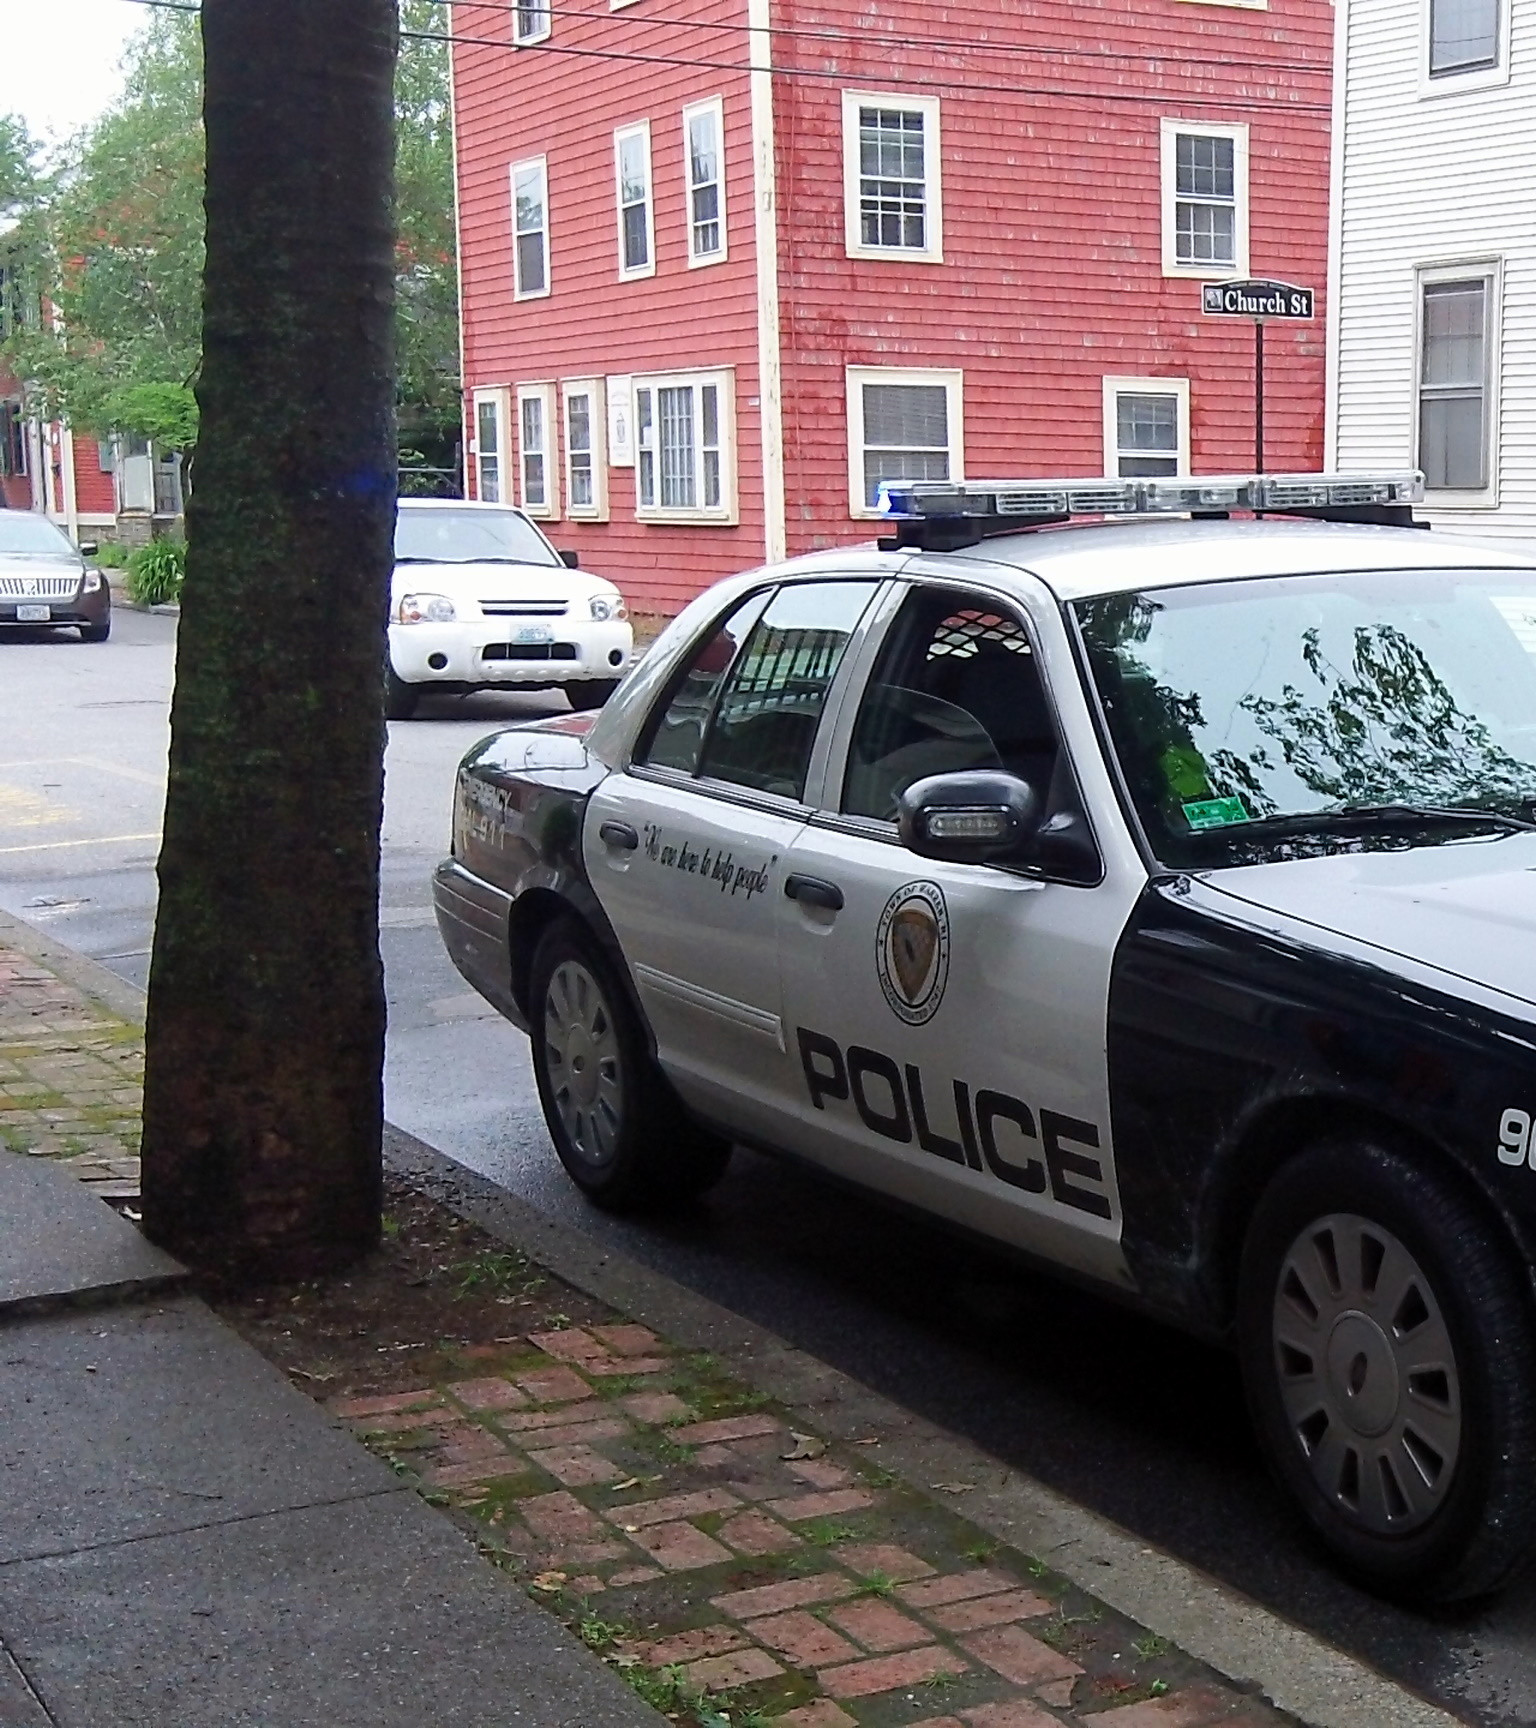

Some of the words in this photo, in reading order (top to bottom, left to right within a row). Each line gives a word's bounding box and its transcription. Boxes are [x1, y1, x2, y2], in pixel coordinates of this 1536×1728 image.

[1224, 289, 1286, 313] Church
[1290, 293, 1308, 315] St
[677, 841, 699, 873] here
[699, 847, 711, 876] to
[711, 850, 734, 893] help
[796, 1026, 1112, 1221] POLICE
